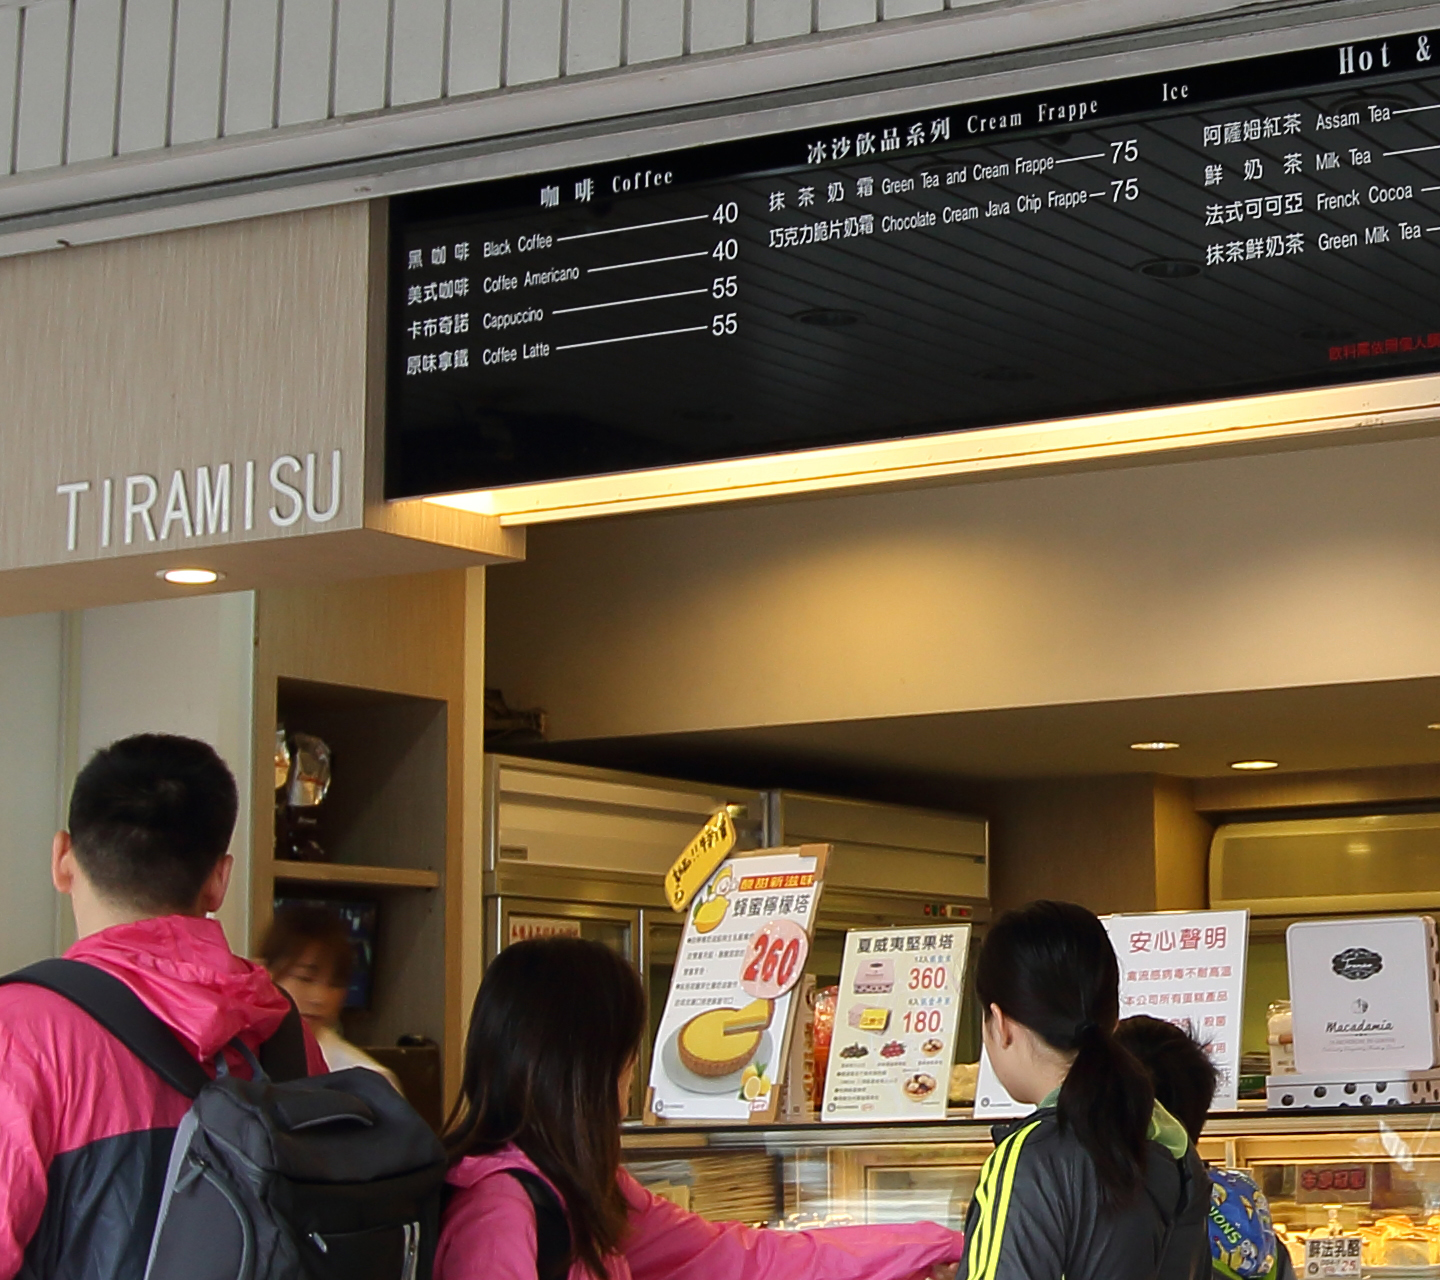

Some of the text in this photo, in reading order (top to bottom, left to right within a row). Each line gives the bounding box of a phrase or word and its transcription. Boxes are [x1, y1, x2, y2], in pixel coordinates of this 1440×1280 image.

[1338, 45, 1391, 76] Hot
[1415, 34, 1433, 62] &
[1162, 82, 1190, 102] Ice
[807, 98, 1099, 164] 冰沙飲品系列 Cream Frappe
[1203, 113, 1302, 147] 阿薩姆紅茶
[1315, 111, 1360, 131] Assam
[1368, 105, 1391, 123] Tea
[540, 170, 673, 208] 咖啡 Coffee
[768, 139, 1139, 212] 抹茶奶霜 Green Tea and Cream Frappe 75
[1204, 152, 1303, 187] 鮮奶茶
[1316, 152, 1341, 171] Milk
[1349, 149, 1372, 166] Tea
[768, 177, 1139, 248] 巧克力脆片奶霜 Chocolate Cream Java Chip Frappe 75
[1205, 192, 1304, 226] 法式可可亞
[1317, 189, 1360, 211] Frenck
[1368, 185, 1413, 204] Cocoa
[408, 202, 739, 269] 黑咖啡 Black Coffee 40
[1206, 232, 1305, 266] 抹茶鮮奶茶
[1318, 233, 1358, 251] Green
[1365, 225, 1390, 245] Milk
[1398, 222, 1421, 240] Tea
[407, 239, 739, 305] 美式咖啡 Coffee Americano 40
[407, 276, 738, 340] 卡布奇諾 Cappuccino 55
[406, 313, 738, 376] 原味拿鐵 Coffee Latte 55
[57, 449, 342, 551] TIRAMISU
[732, 894, 810, 917] 蜂蜜檸檬塔
[743, 934, 799, 986] 260
[857, 934, 954, 954] 夏威夷堅果塔
[1129, 926, 1227, 953] 安心聲明
[908, 966, 946, 990] 360
[903, 1010, 941, 1033] 180
[1325, 1019, 1393, 1033] Macadamia
[1340, 1260, 1357, 1272] 25
